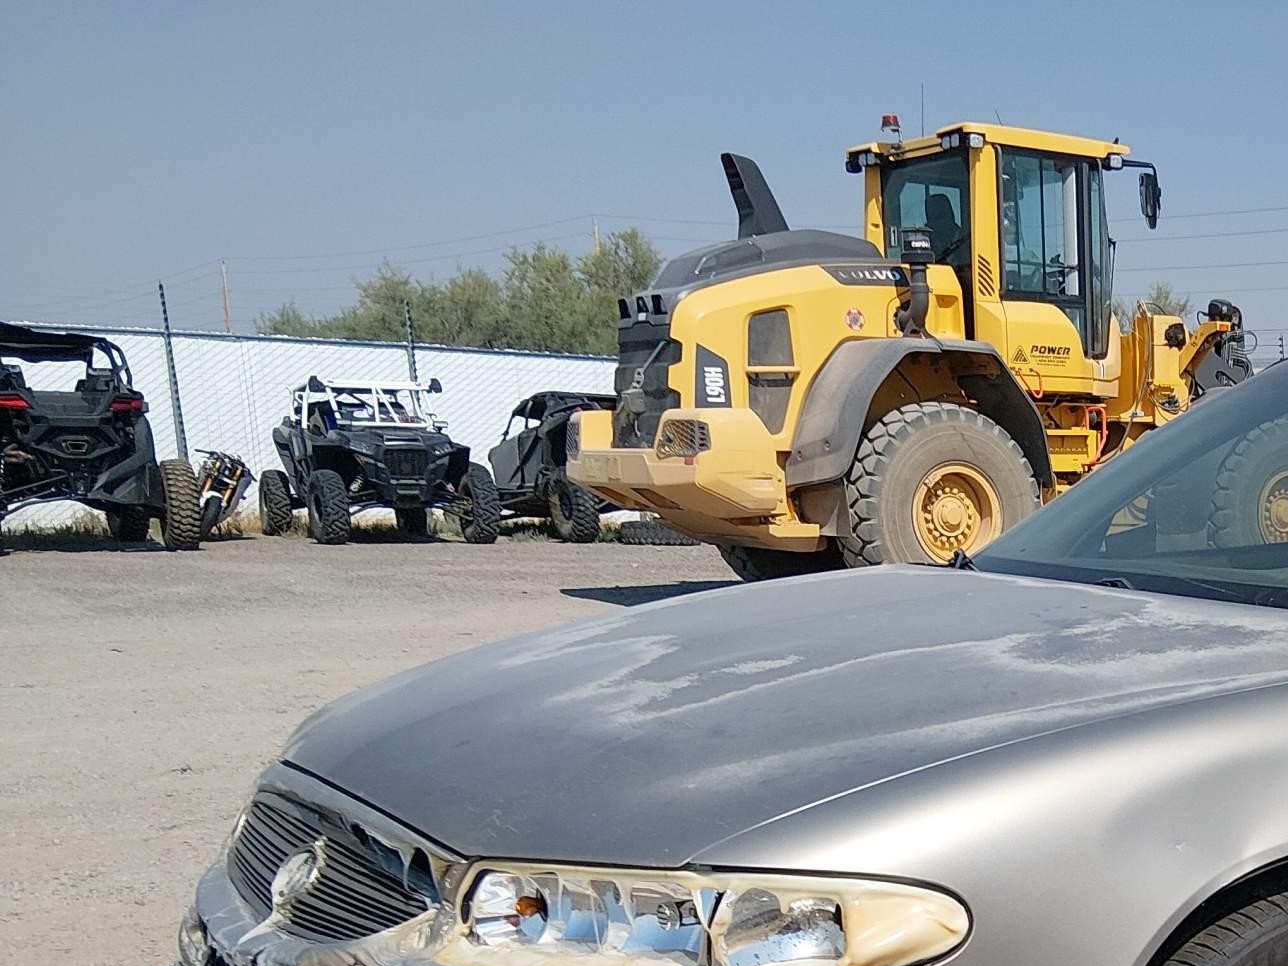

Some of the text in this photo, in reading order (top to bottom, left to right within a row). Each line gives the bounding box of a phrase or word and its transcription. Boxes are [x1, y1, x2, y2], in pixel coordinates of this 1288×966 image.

[838, 268, 901, 281] VOLVO
[1030, 345, 1071, 355] POWER
[703, 366, 726, 403] L90H
